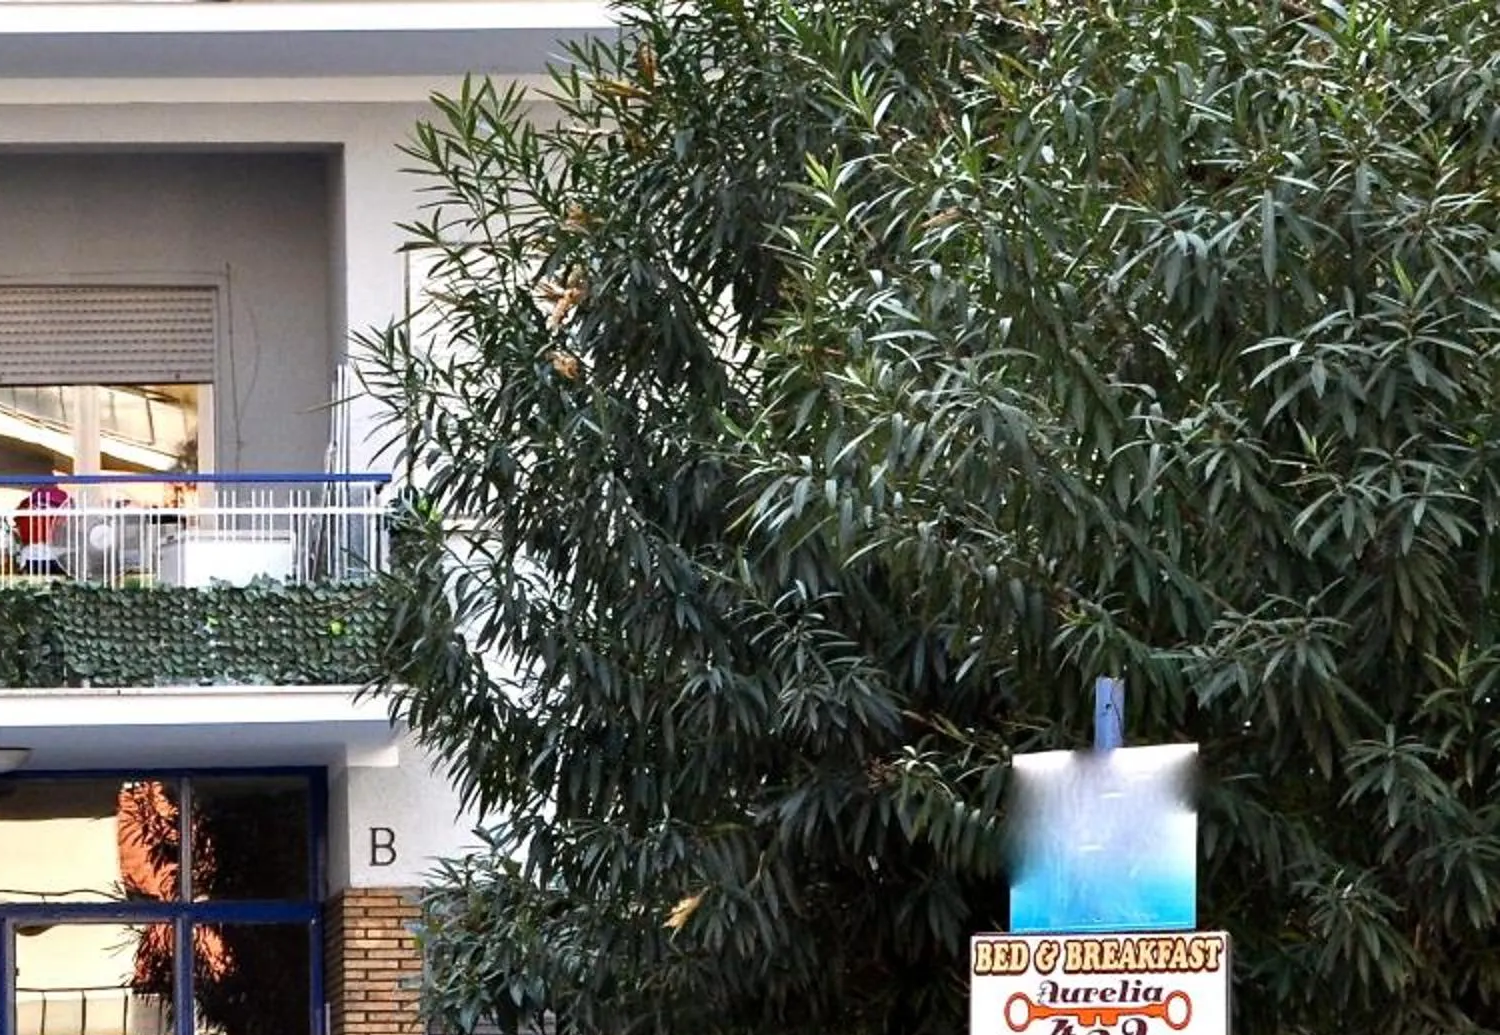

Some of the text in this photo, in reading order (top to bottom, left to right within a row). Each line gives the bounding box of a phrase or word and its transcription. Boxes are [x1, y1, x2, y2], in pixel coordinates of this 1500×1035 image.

[369, 827, 397, 866] B
[974, 937, 1223, 975] BED & BREAKFAST
[1037, 979, 1163, 1003] Aurelia
